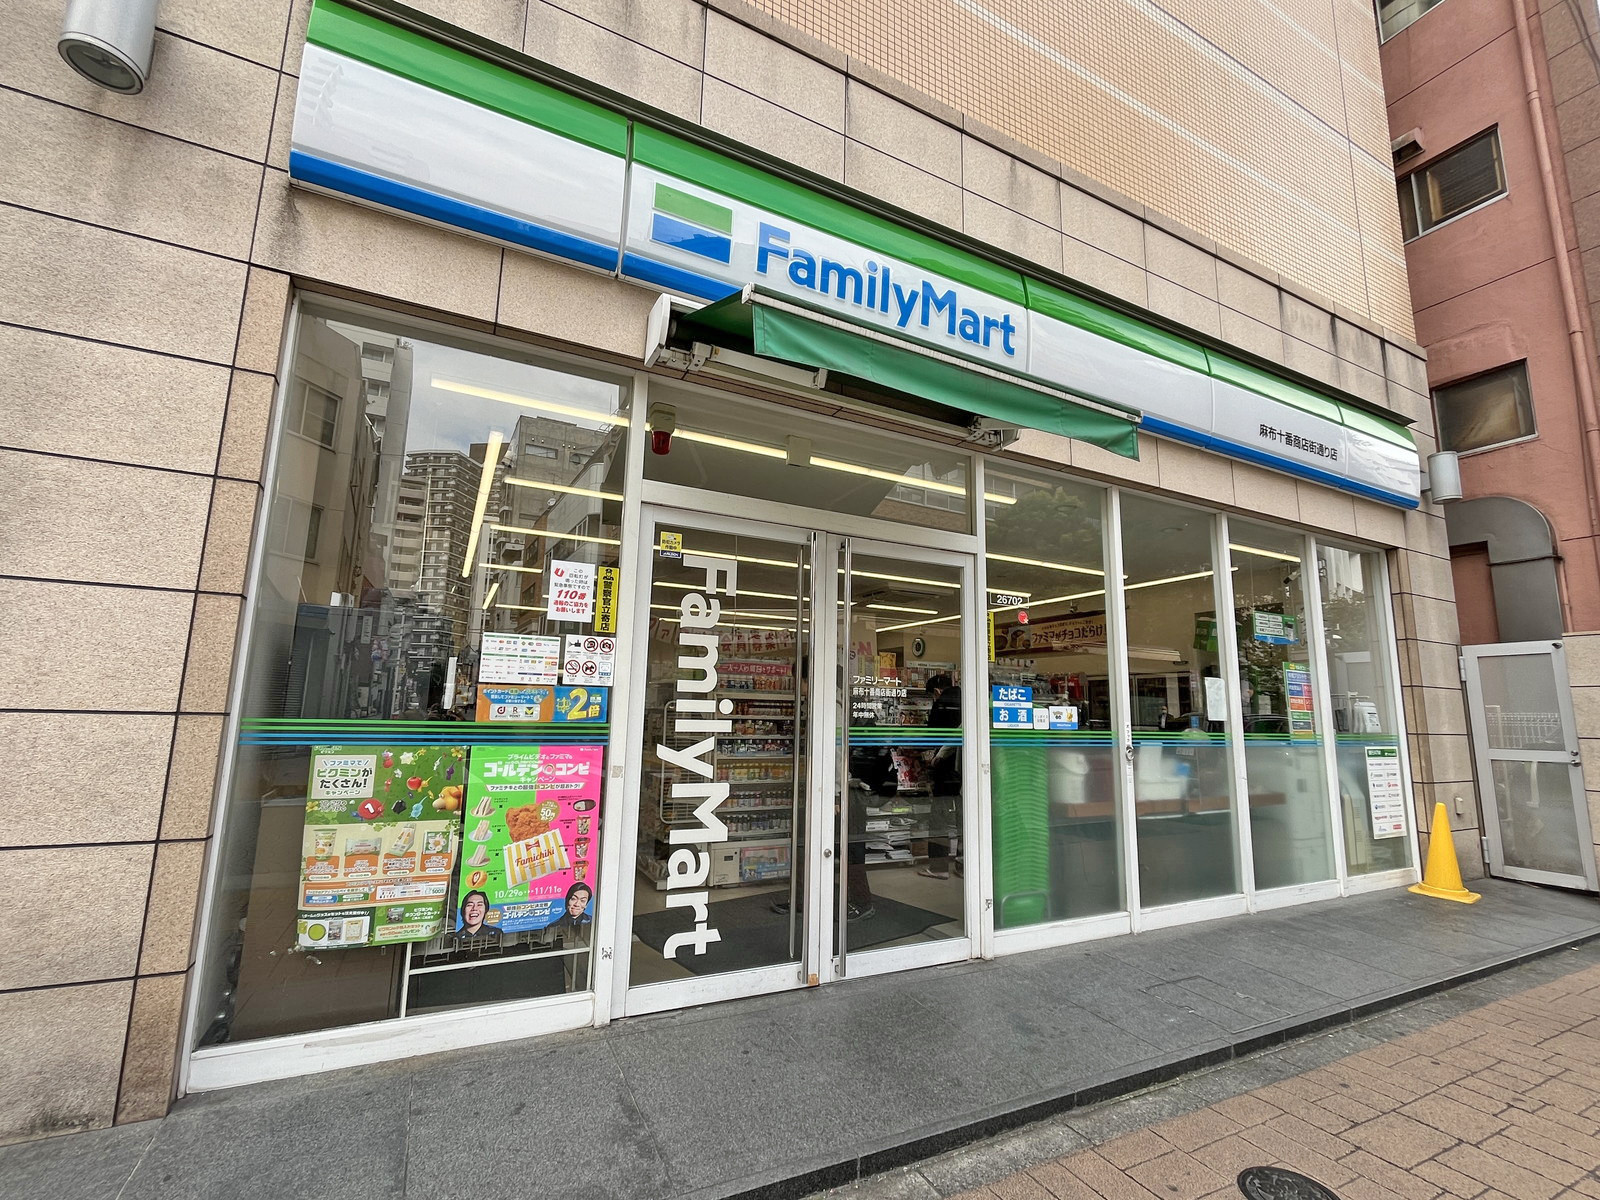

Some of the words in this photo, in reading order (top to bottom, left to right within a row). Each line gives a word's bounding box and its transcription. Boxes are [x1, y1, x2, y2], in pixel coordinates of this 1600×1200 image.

[756, 221, 1015, 356] FamilyMart
[1259, 423, 1338, 461] 麻布十番商店街通り店
[557, 589, 587, 600] 110番
[996, 594, 1023, 605] 26702
[553, 600, 589, 608] 通報のご協力を
[600, 581, 613, 631] 警察官立寄店
[555, 606, 586, 614] お願いします
[852, 675, 902, 686] ファミリーマート
[852, 687, 907, 698] 麻布十番商店街通り店
[998, 687, 1027, 700] たばこ
[656, 552, 738, 960] FamilyMart
[317, 767, 373, 778] ピクミンが
[320, 778, 368, 789] たくさん!
[514, 846, 555, 867] Famichiki
